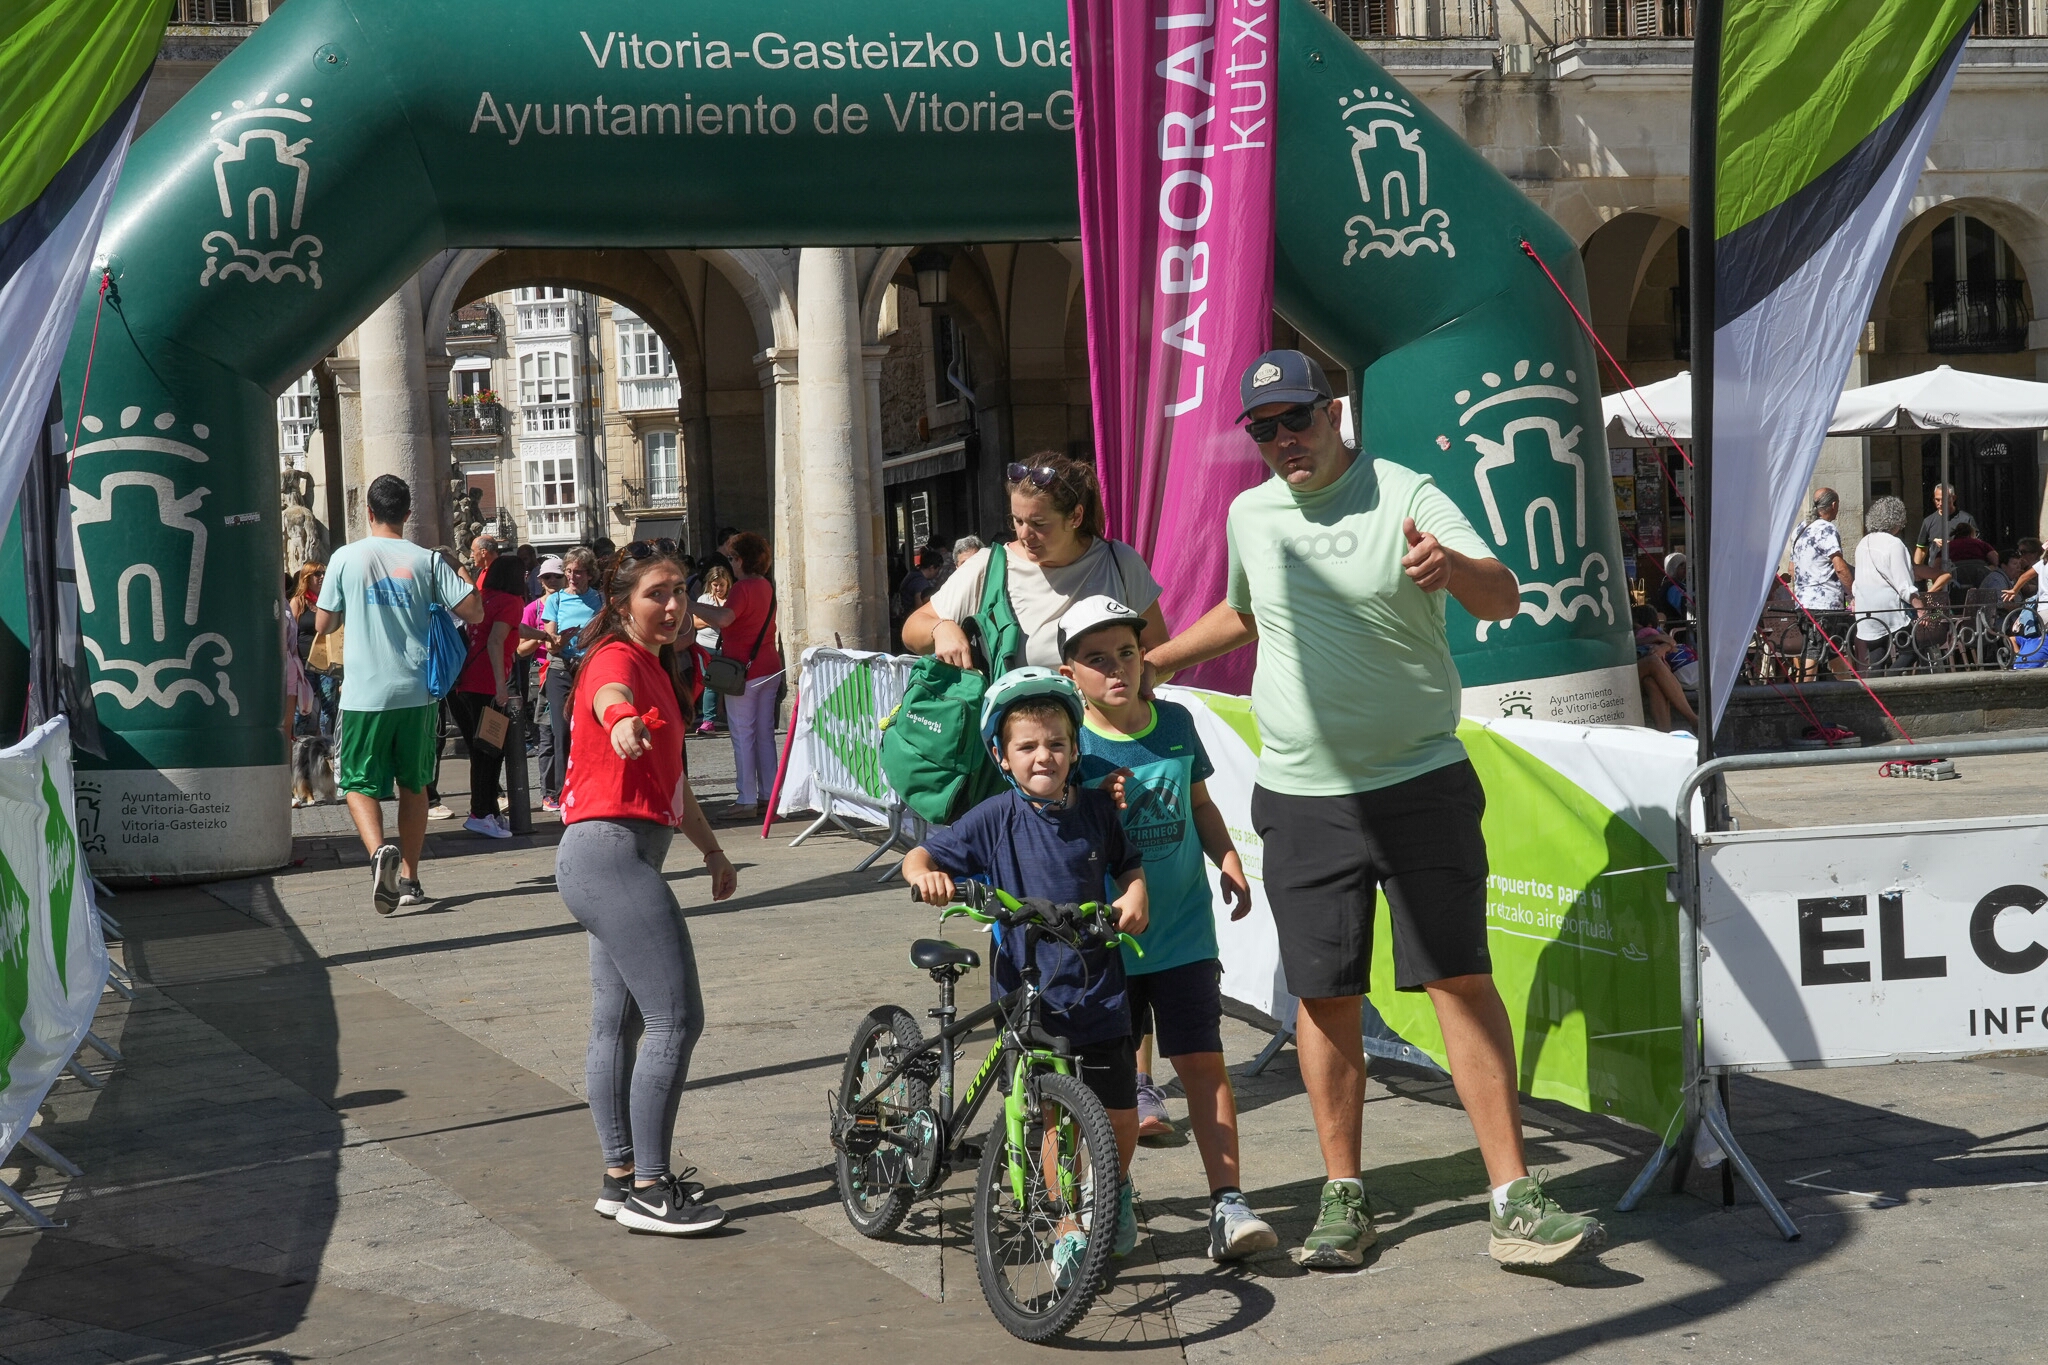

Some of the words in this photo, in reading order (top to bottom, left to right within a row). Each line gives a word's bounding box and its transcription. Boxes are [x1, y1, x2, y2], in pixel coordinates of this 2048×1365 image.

[580, 31, 979, 70] Vitoria-Gasteizko
[1223, 0, 1268, 152] kutx
[469, 91, 796, 146] Ayuntamiento
[813, 93, 869, 134] de
[883, 90, 1075, 132] Vitoria-G
[1155, 0, 1216, 418] LABORAL
[1550, 688, 1613, 707] Ayuntamiento
[1551, 707, 1564, 717] de
[1566, 696, 1625, 714] Vitoria-Gasteiz
[1557, 710, 1625, 725] oria-Gasteizko
[121, 791, 211, 803] Ayuntamiento
[121, 804, 138, 815] de
[142, 803, 231, 816] Vitoria-Gasteiz
[121, 818, 228, 831] Vitoria-Gasteizko
[1130, 823, 1178, 841] PIRINEOS
[122, 833, 159, 844] Udala
[1557, 885, 1587, 906] para
[1591, 888, 1602, 909] ti
[1537, 908, 1613, 941] aireportuak
[1798, 893, 1947, 987] EL
[1970, 1005, 2048, 1037] INF
